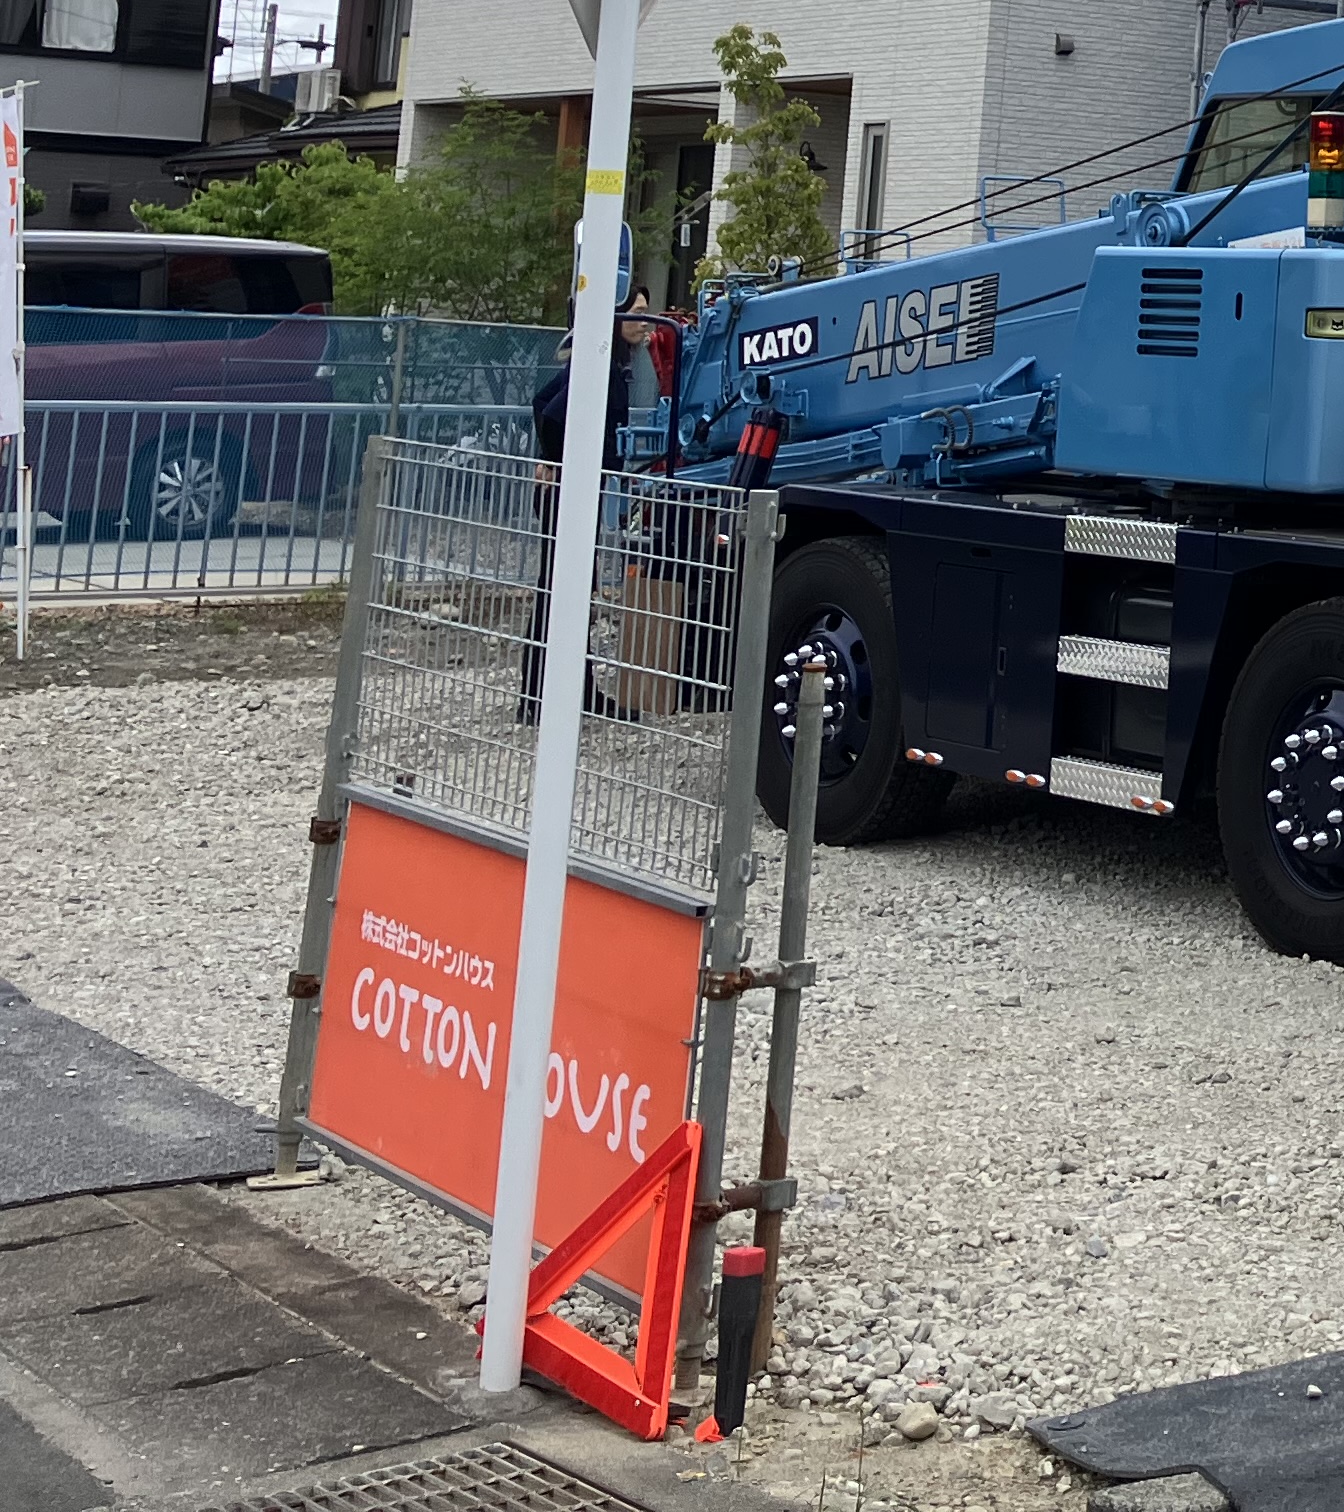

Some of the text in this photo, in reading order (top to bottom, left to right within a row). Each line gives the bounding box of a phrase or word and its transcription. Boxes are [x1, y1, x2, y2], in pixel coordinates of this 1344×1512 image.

[743, 322, 813, 365] KATO
[361, 908, 495, 992] 株式会社コットンハウス
[351, 967, 651, 1164] COTTON OUSE
